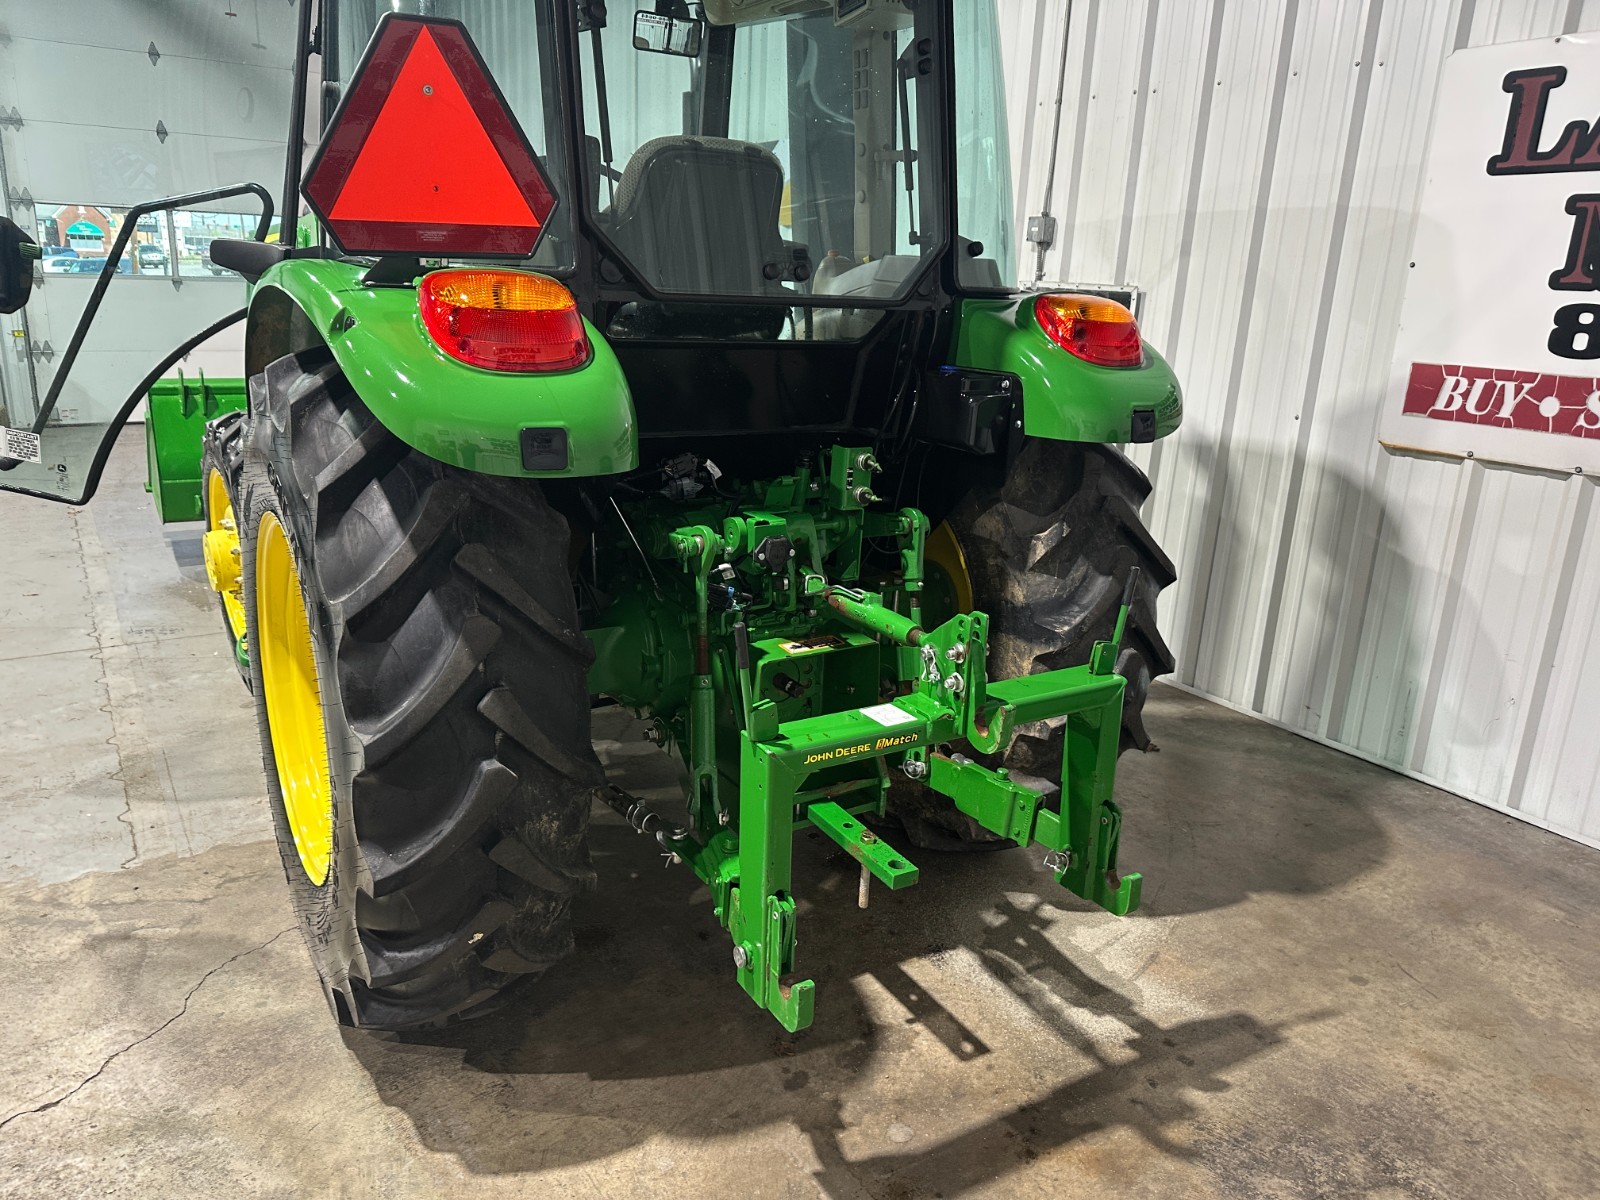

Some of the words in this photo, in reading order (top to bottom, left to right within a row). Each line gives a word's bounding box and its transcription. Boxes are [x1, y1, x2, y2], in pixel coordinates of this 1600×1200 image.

[1432, 375, 1535, 419] BUY
[804, 751, 834, 765] JOHN
[836, 743, 871, 757] DEERE
